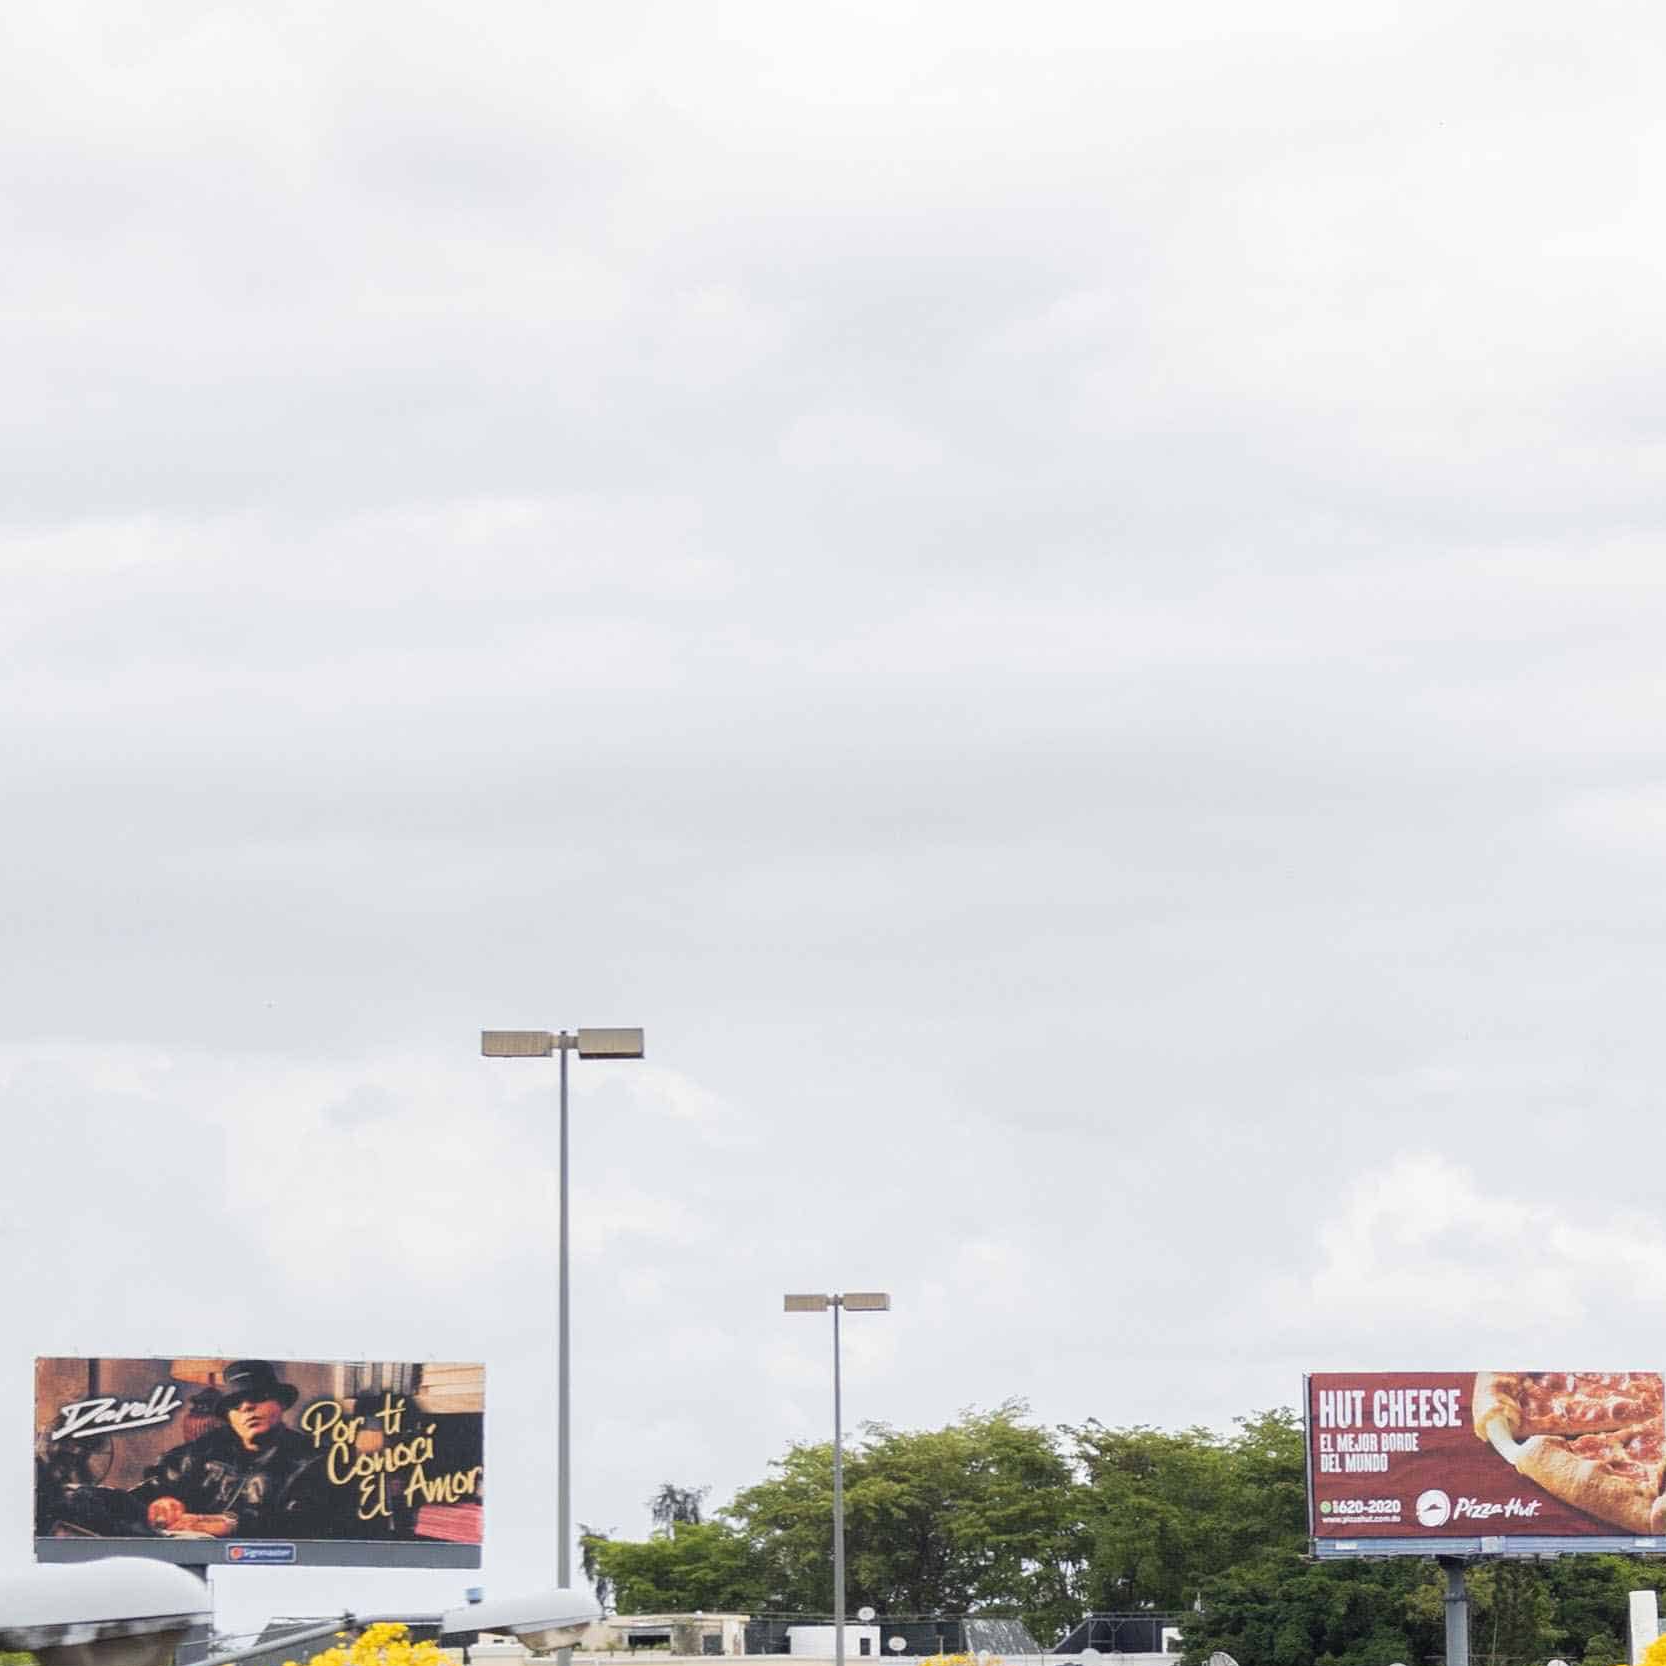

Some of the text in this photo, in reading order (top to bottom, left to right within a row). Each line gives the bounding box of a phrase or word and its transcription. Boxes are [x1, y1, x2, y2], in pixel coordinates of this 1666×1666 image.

[51, 1385, 183, 1440] Darell
[301, 1401, 365, 1448] Por
[1319, 1389, 1463, 1428] HUT CHEESE
[1319, 1432, 1420, 1452] EL MEJOR BORDE
[1320, 1453, 1389, 1472] DEL MUNDO
[358, 1464, 482, 1520] El Amor
[1453, 1497, 1542, 1520] Pizza Hut
